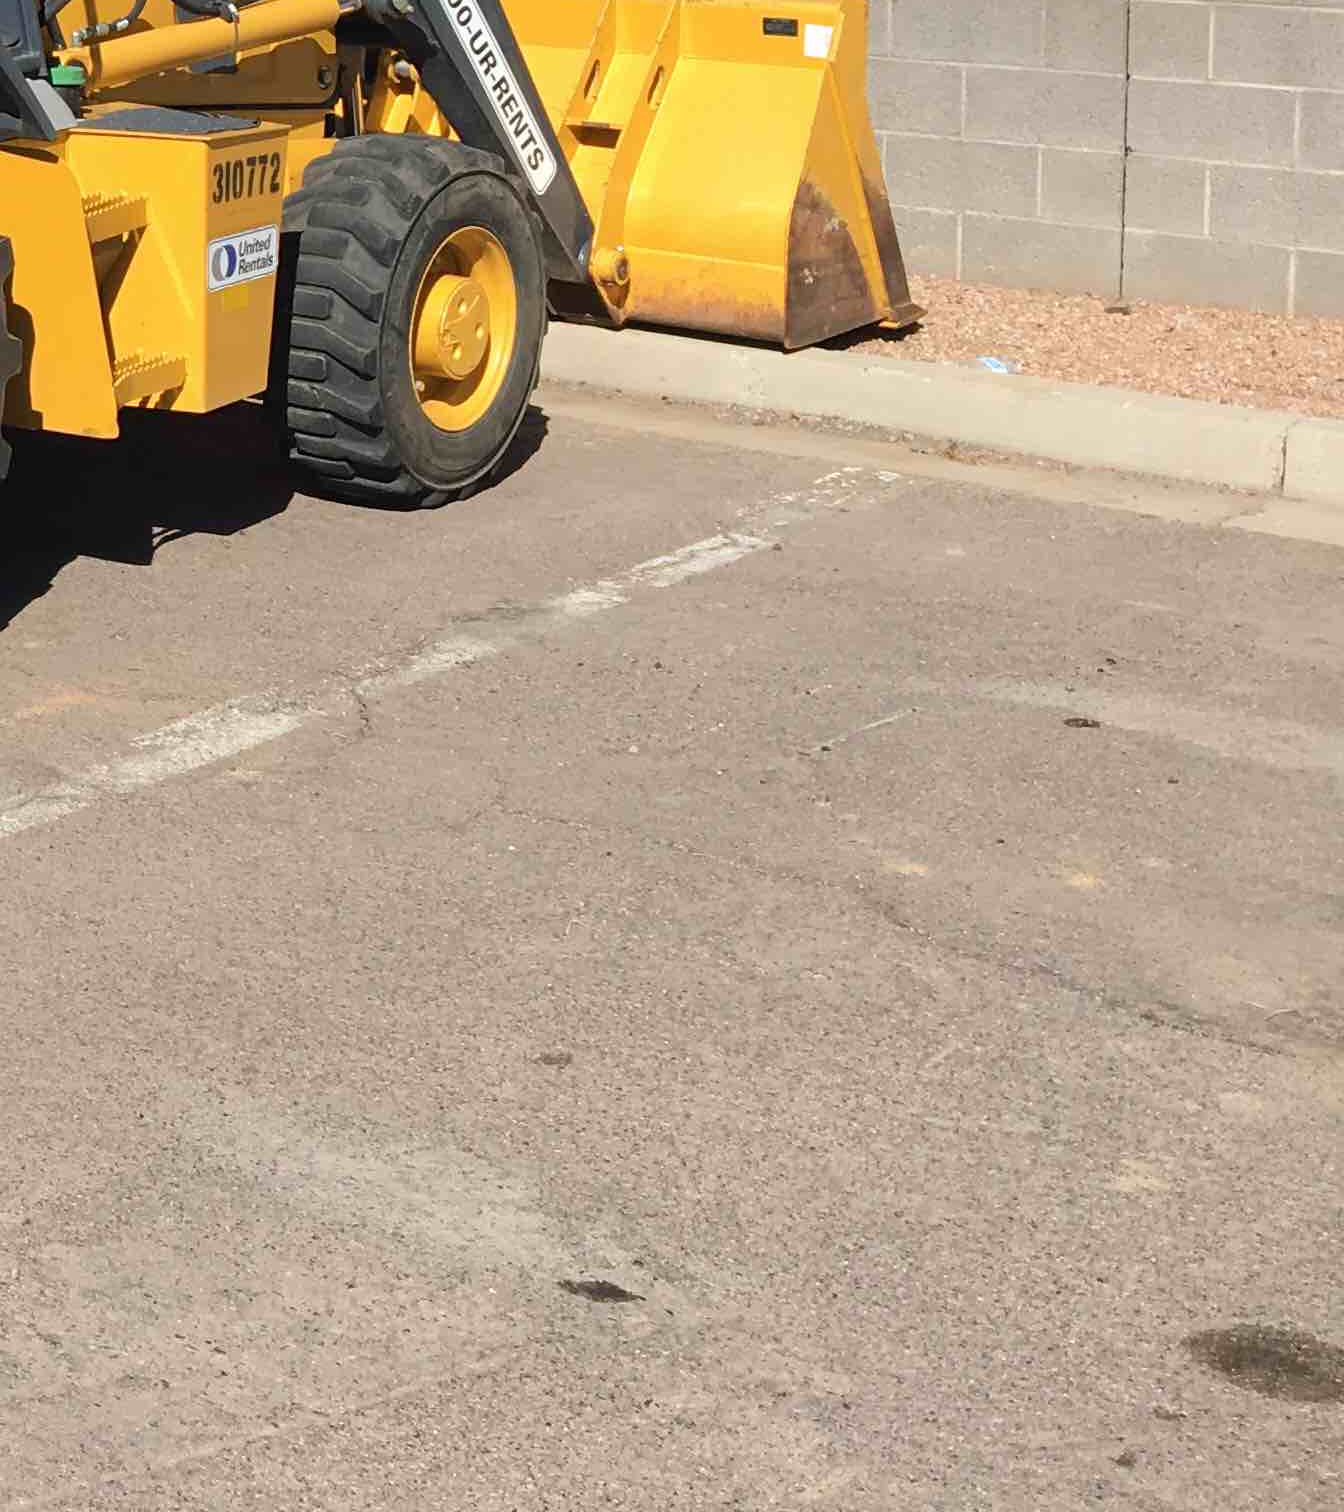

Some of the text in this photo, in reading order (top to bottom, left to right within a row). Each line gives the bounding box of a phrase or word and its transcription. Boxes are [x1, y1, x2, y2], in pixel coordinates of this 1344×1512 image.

[213, 152, 280, 204] 310772
[238, 234, 272, 258] United
[238, 254, 274, 276] Rentals
